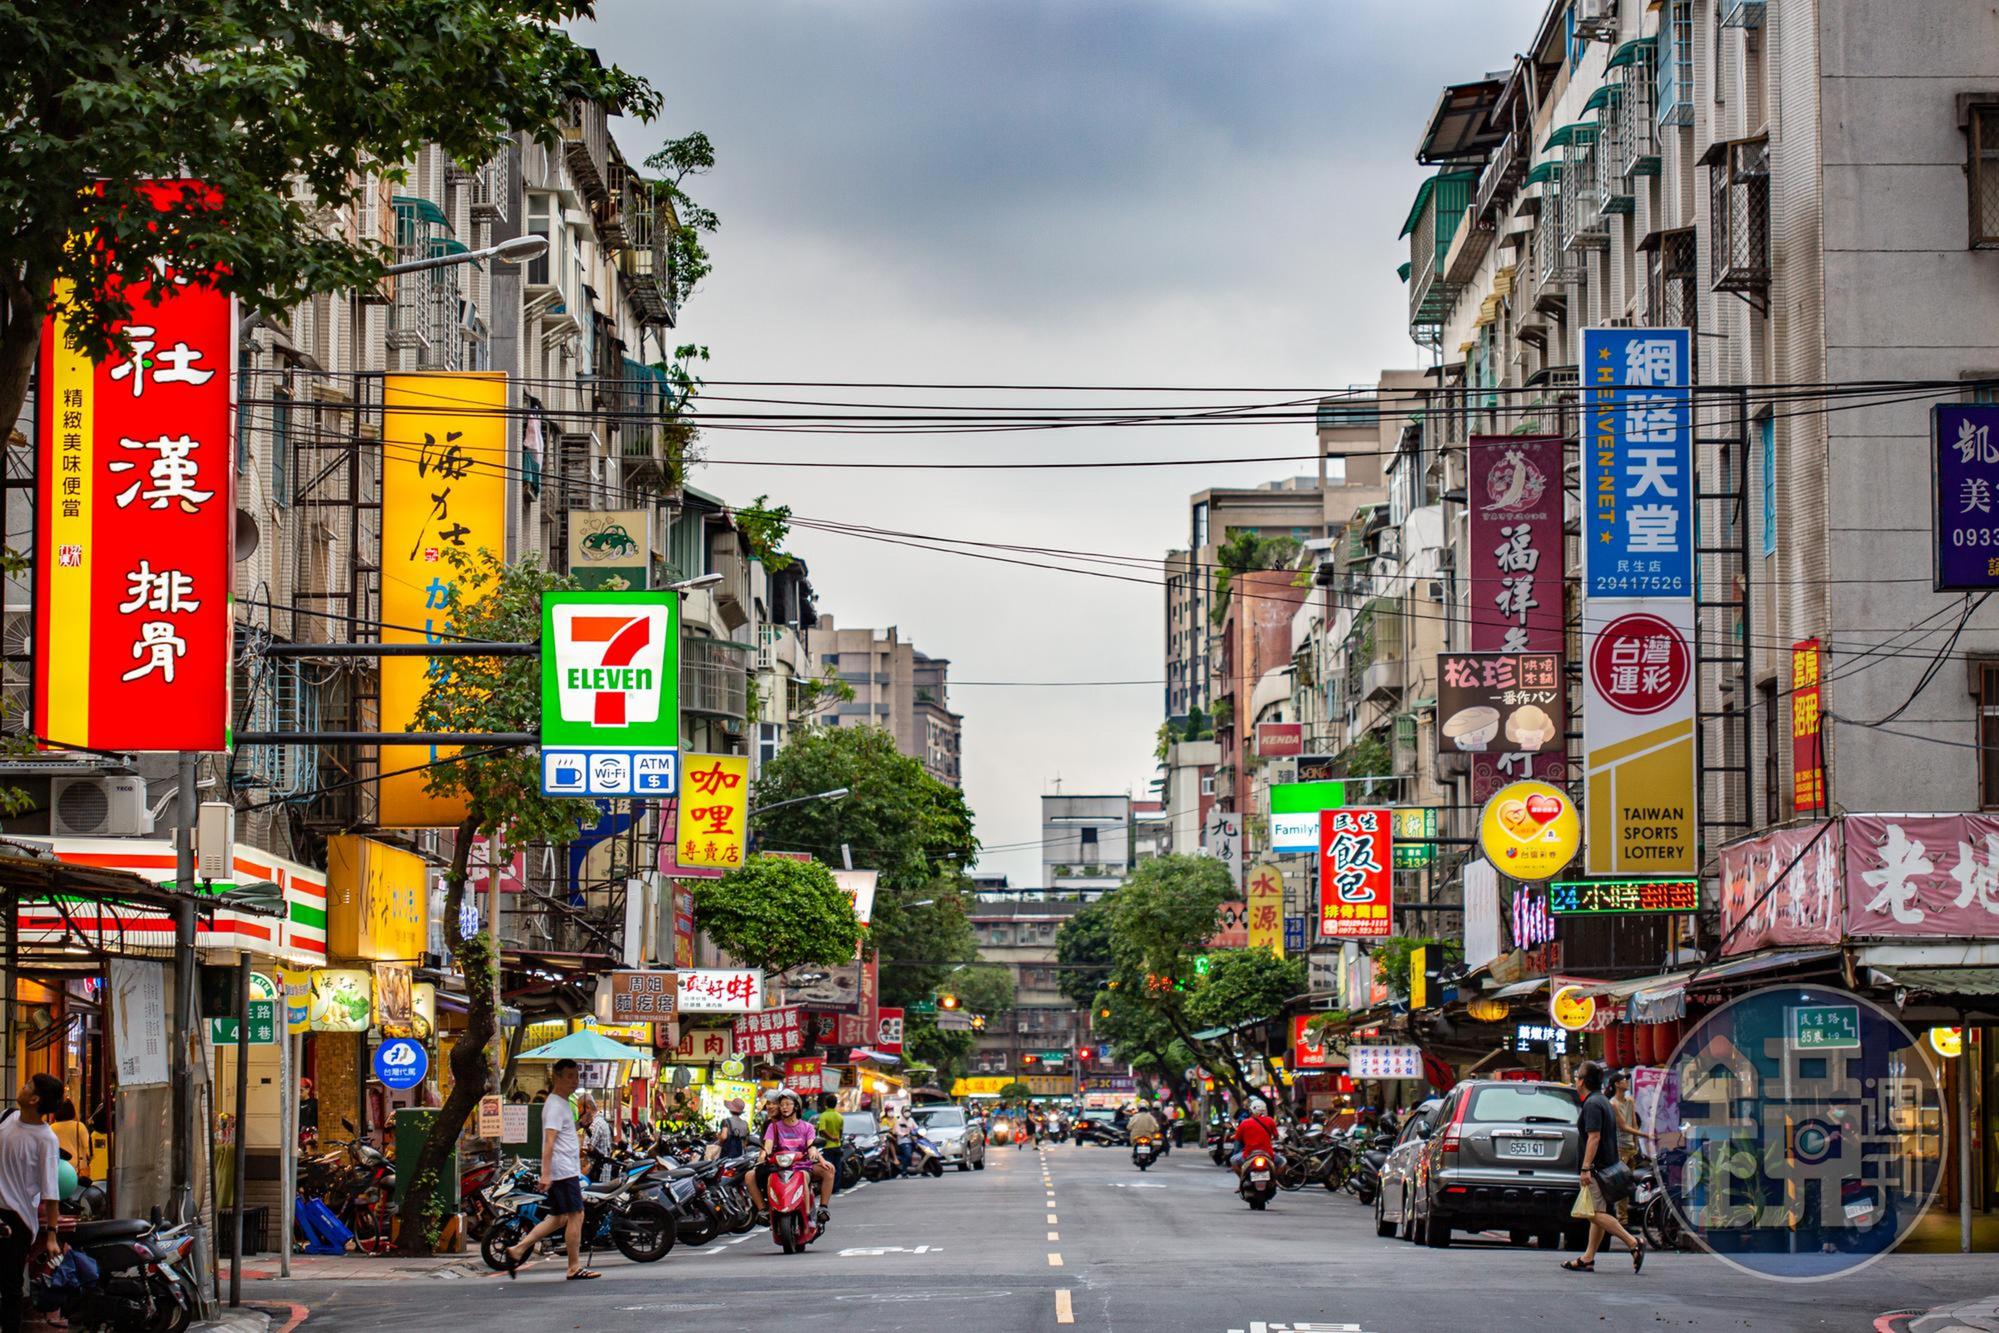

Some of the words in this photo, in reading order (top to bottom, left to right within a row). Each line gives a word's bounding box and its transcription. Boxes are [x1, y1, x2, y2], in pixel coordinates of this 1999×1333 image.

[62, 388, 82, 518] 精緻美味便當
[1597, 367, 1616, 525] HEAVEN-NET
[1624, 339, 1680, 554] 網路天堂
[109, 255, 215, 683] 社漢排骨
[1960, 478, 1999, 513] 美
[1617, 560, 1662, 573] 民生店
[1596, 576, 1683, 590] 29417526
[1611, 634, 1672, 663] 台灣
[571, 616, 650, 725] 7
[1444, 656, 1517, 689] 松珍
[1523, 658, 1553, 671] 烘焙
[1609, 665, 1672, 696] 運彩
[1489, 689, 1557, 705] 一番作パン
[1261, 735, 1300, 746] KENDA
[595, 768, 626, 779] Wi-Fi
[639, 758, 669, 769] ATM
[689, 760, 741, 836] 咖哩
[1334, 812, 1379, 832] 民生
[1623, 807, 1684, 821] TAIWAN
[1624, 826, 1679, 840] SPORTS
[681, 840, 739, 864] 專賣店
[1624, 845, 1685, 859] LOTTERY
[1327, 832, 1382, 902] 飯包
[629, 975, 664, 993] 周姐
[615, 993, 674, 1013] 麵疙瘩
[1800, 1012, 1840, 1026] 民生路
